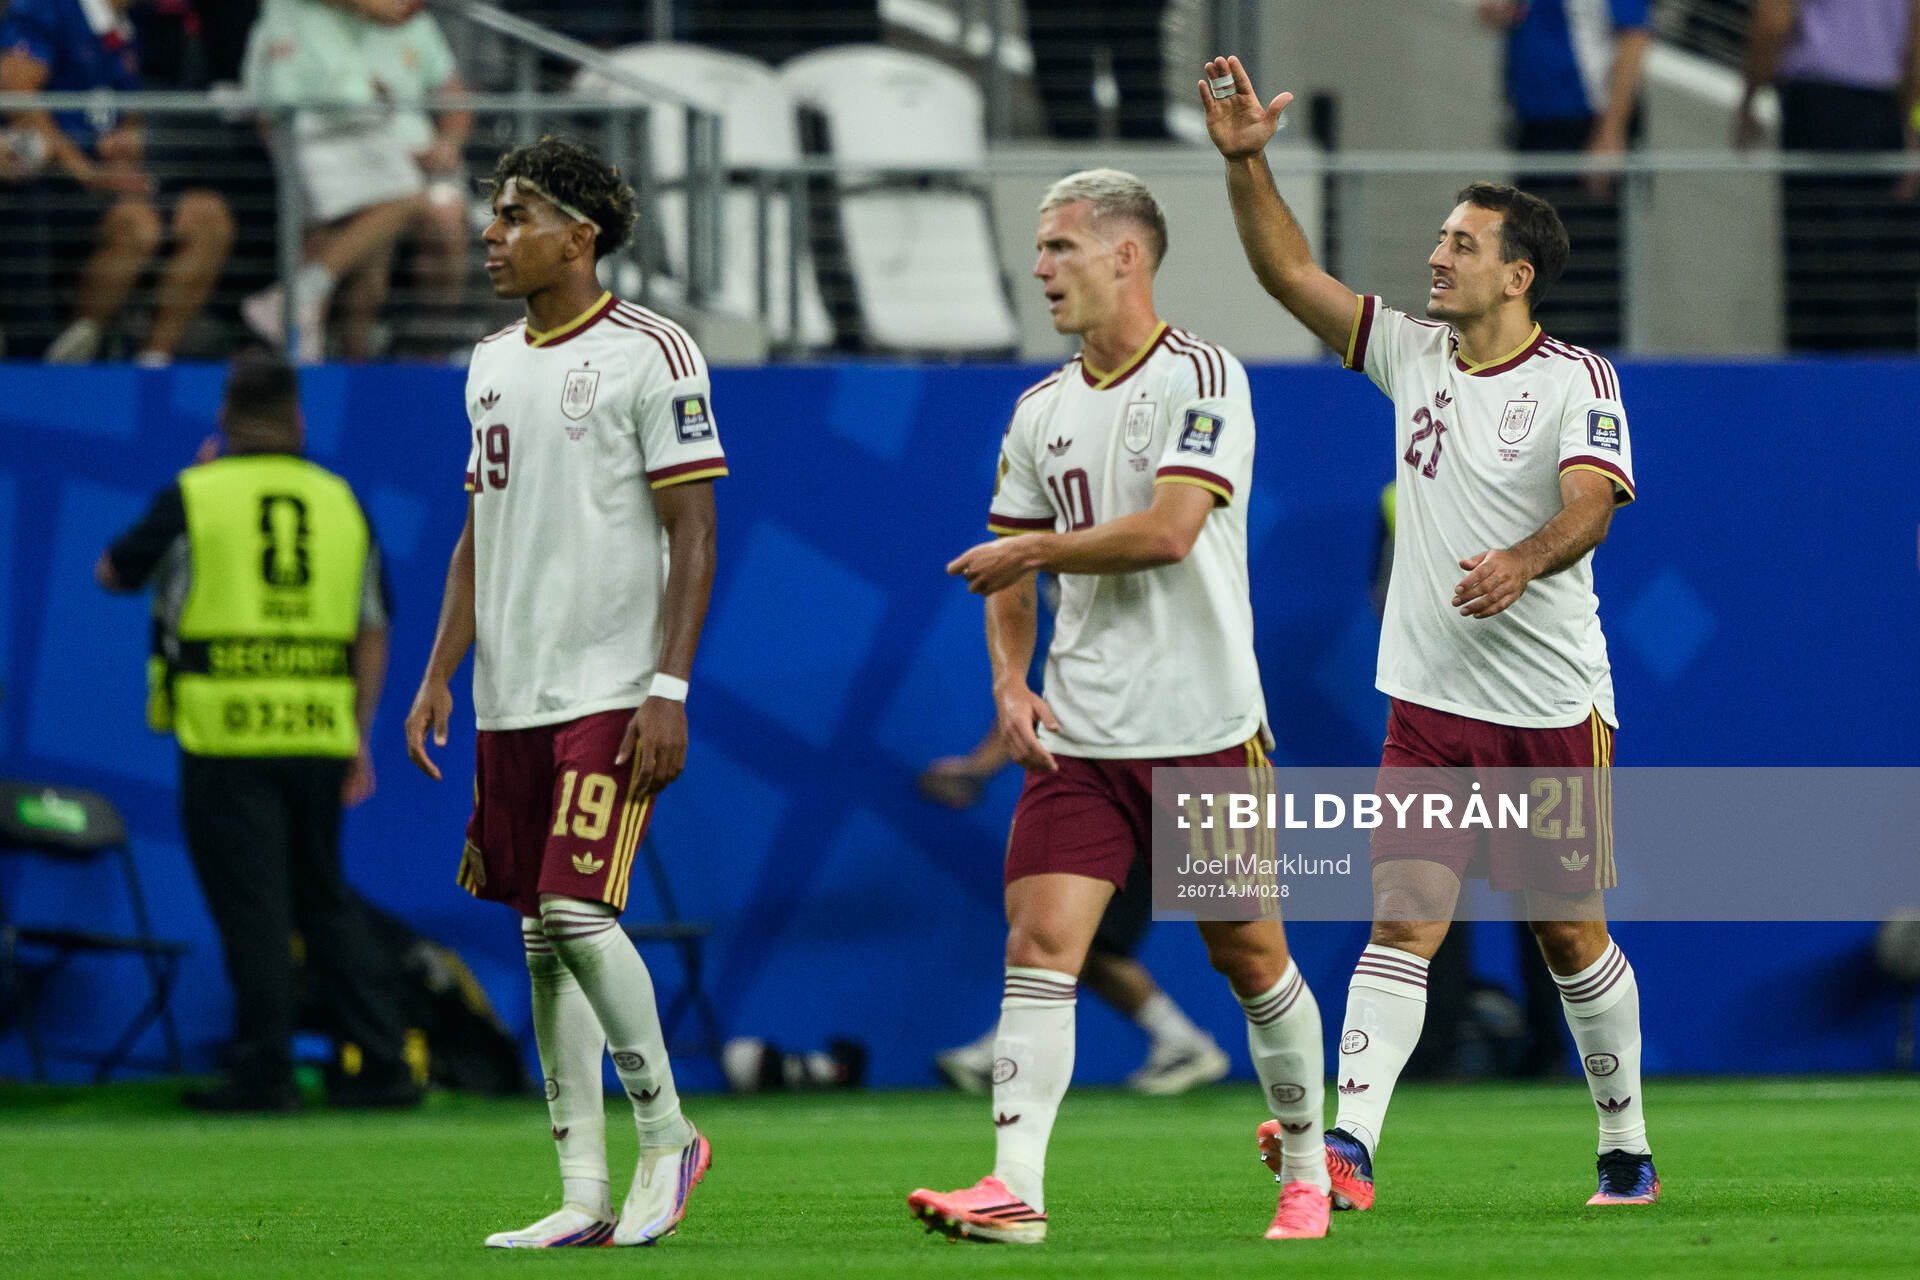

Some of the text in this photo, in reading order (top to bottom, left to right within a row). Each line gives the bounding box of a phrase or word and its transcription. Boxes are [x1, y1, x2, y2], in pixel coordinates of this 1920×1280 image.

[474, 424, 510, 493] 19
[1404, 406, 1447, 480] 21
[1047, 468, 1094, 534] 10
[552, 770, 617, 841] 19
[1530, 776, 1586, 840] 21
